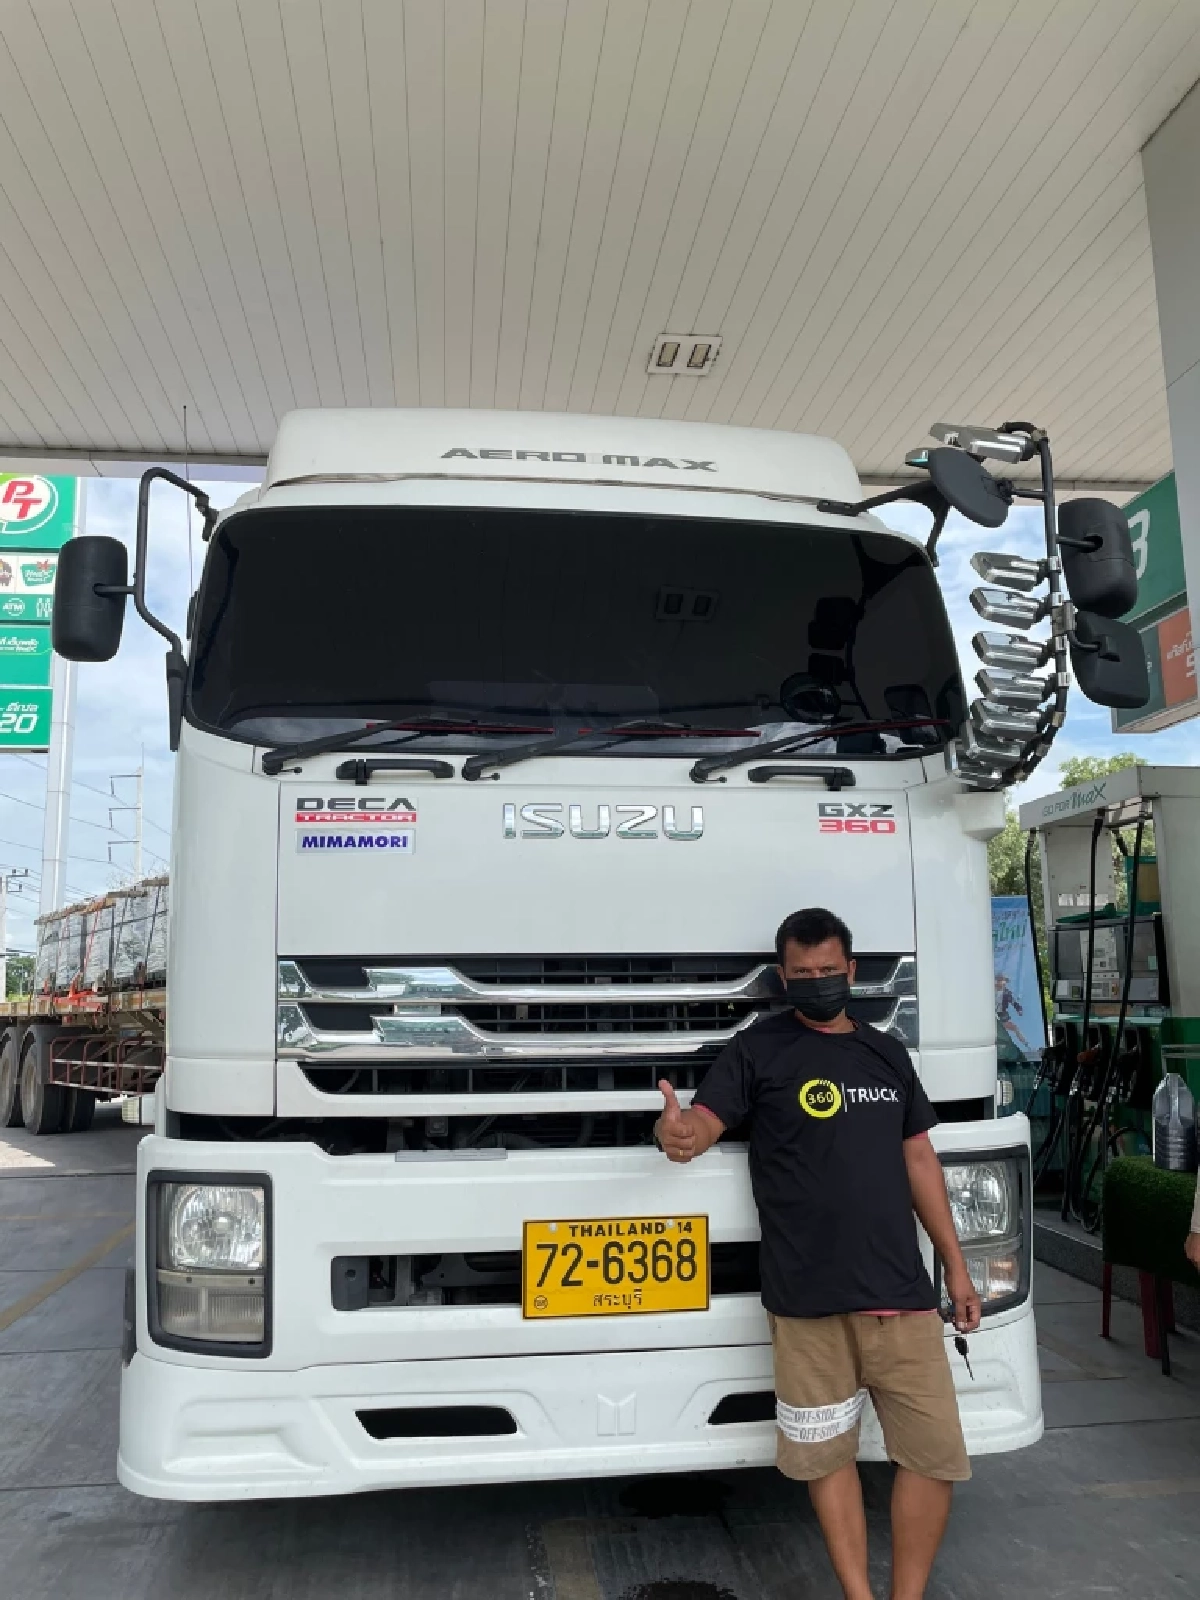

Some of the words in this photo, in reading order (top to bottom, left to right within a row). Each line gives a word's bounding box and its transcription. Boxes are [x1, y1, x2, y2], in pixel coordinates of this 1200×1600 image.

[440, 447, 587, 463] AERO
[602, 454, 718, 473] MAX
[2, 480, 43, 520] PT
[296, 797, 417, 811] DECA
[818, 802, 895, 818] GXZ
[296, 811, 417, 823] TRACTOR
[502, 802, 704, 841] ISUZU
[818, 818, 896, 834] 360
[302, 835, 409, 848] MIMAMORI
[846, 1087, 900, 1103] TRUCK
[569, 1222, 666, 1237] THAILAND
[677, 1221, 693, 1234] 14
[536, 1238, 698, 1288] 72-6368
